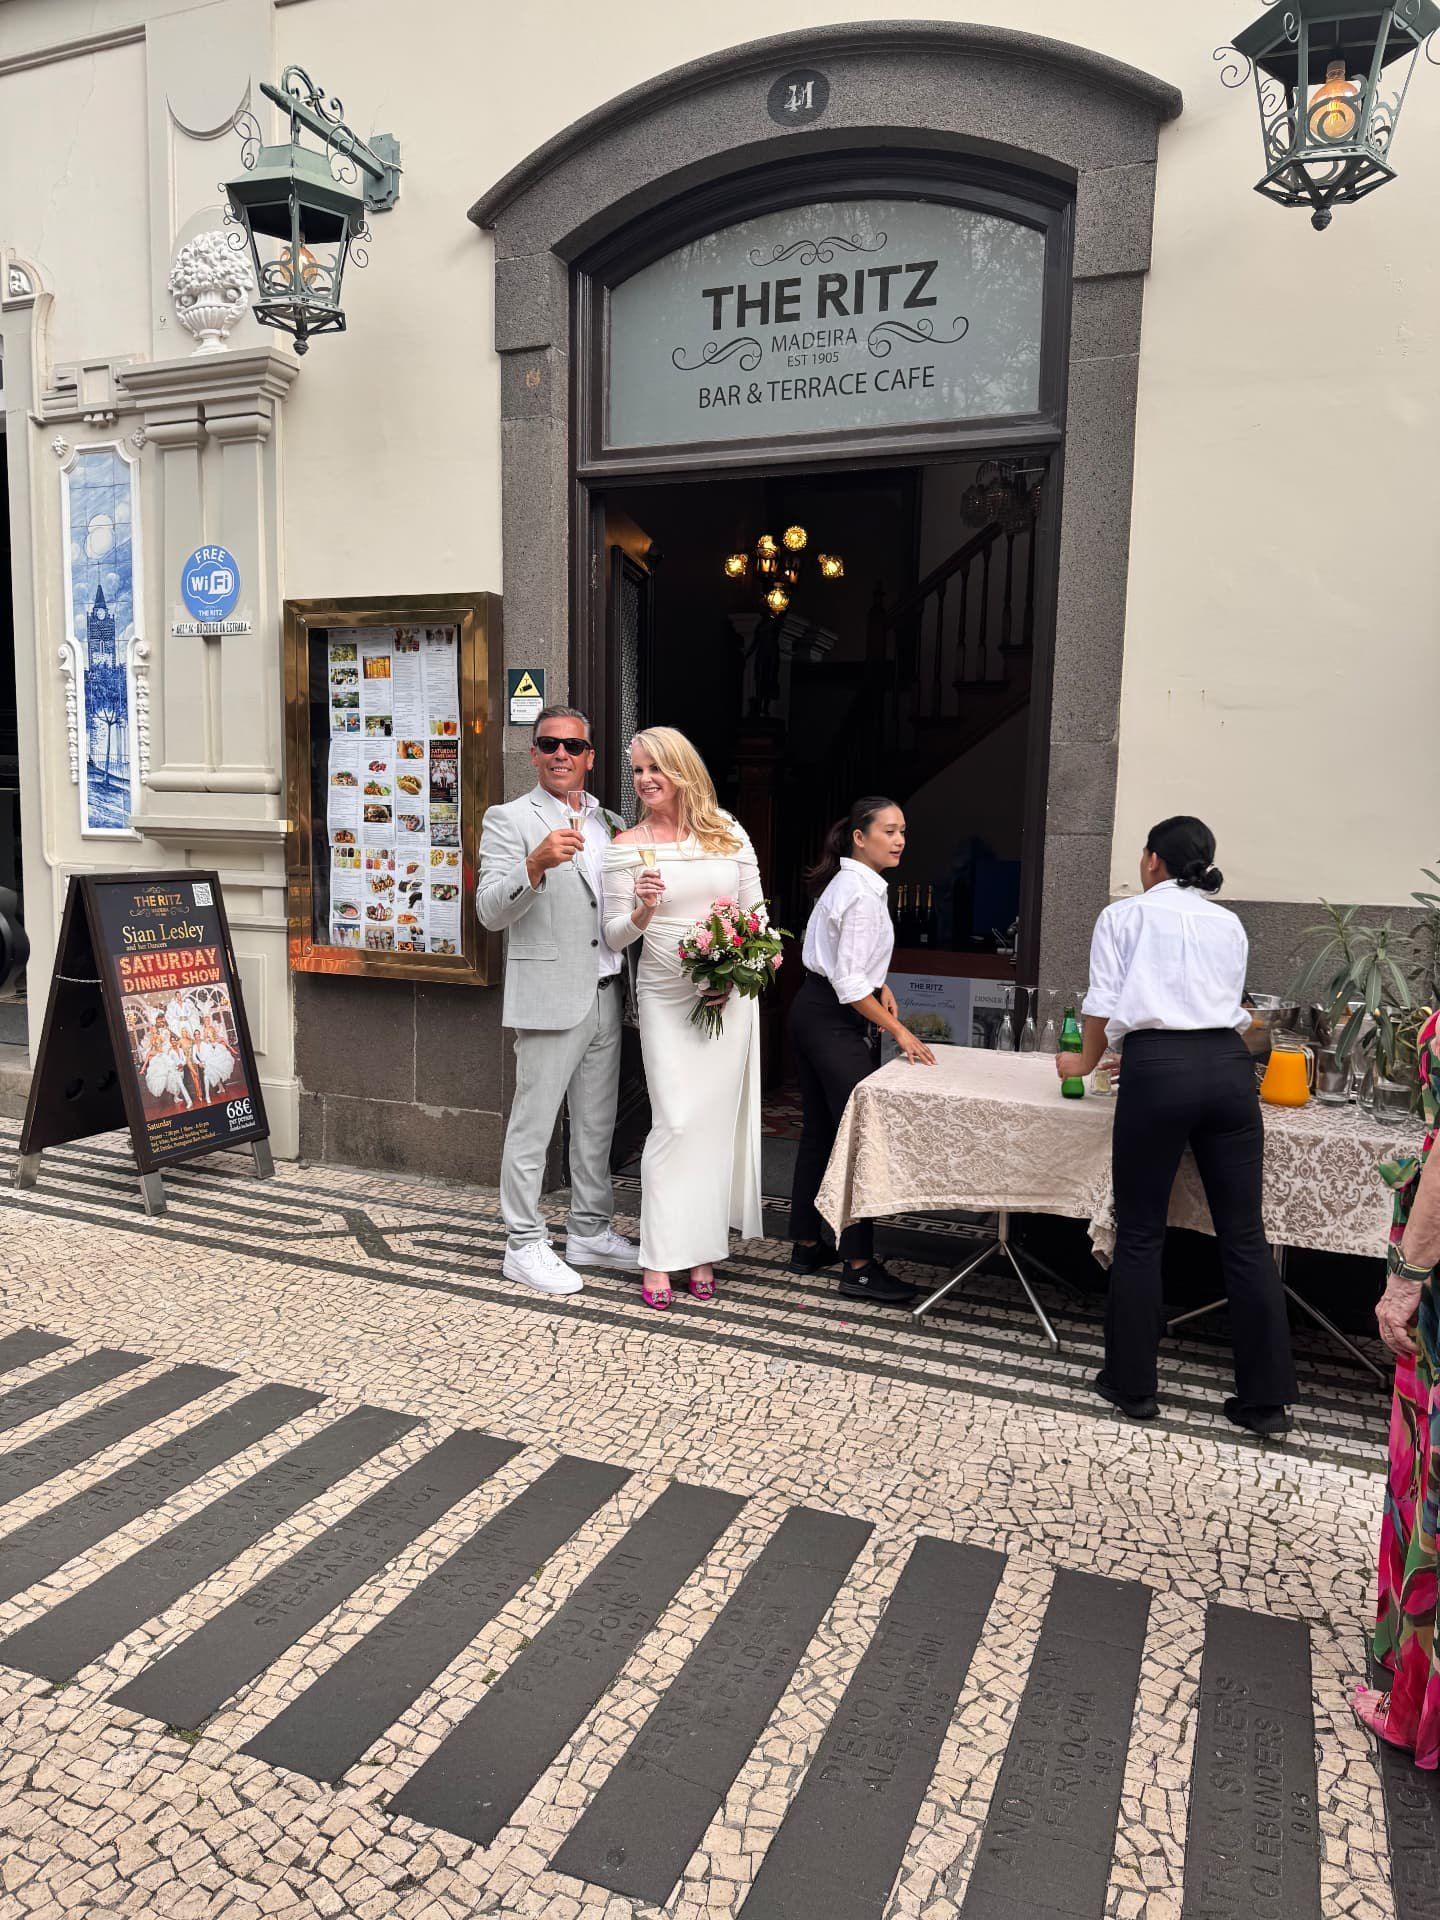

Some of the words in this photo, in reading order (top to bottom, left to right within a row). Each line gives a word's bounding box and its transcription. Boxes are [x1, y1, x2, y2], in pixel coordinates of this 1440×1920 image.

[784, 81, 814, 112] 41
[702, 275, 802, 331] THE
[817, 260, 939, 319] RITZ
[771, 327, 858, 353] MADEIRA
[787, 353, 809, 367] EST
[811, 350, 840, 366] 1905
[699, 384, 740, 409] BAR
[746, 380, 763, 403] &
[766, 371, 868, 402] TERRACE
[874, 365, 935, 392] CAFE
[195, 548, 226, 564] FREE
[133, 895, 156, 907] THE
[157, 893, 182, 906] RITZ
[122, 926, 156, 944] Sian
[158, 920, 204, 943] Lesley
[119, 948, 218, 976] SATURDAY
[123, 976, 179, 993] DINNER
[182, 967, 221, 985] SHOW
[909, 982, 925, 990] THE
[925, 982, 944, 991] RITZ
[226, 1098, 252, 1119] 68€
[146, 1119, 172, 1131] Saturday
[229, 1119, 237, 1127] per
[584, 1589, 644, 1643] PONS
[814, 1697, 889, 1787] PIERO
[982, 1736, 1052, 1866] ANDREA
[1288, 1790, 1313, 1847] 1993
